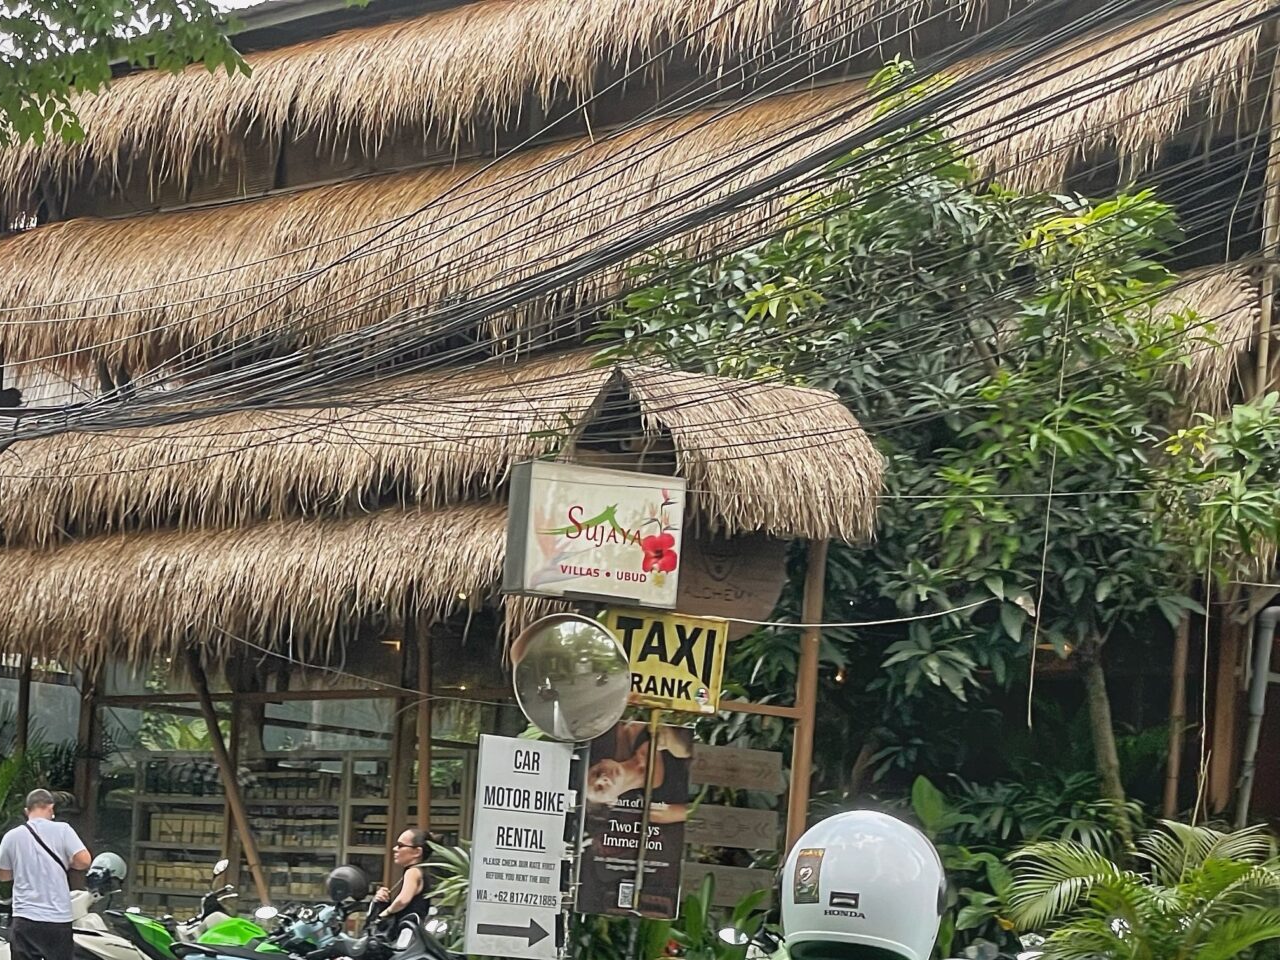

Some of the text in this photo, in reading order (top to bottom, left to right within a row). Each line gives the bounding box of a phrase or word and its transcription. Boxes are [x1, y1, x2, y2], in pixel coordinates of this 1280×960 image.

[561, 565, 647, 583] VILLAS UBUD
[616, 616, 716, 689] TAXI
[631, 673, 693, 700] RANK
[514, 749, 541, 771] CAR
[484, 785, 565, 812] MOTOR BIKE
[496, 826, 546, 850] RENTAL
[608, 819, 660, 838] Two Dys
[476, 889, 488, 900] WA
[824, 909, 866, 919] HONDA
